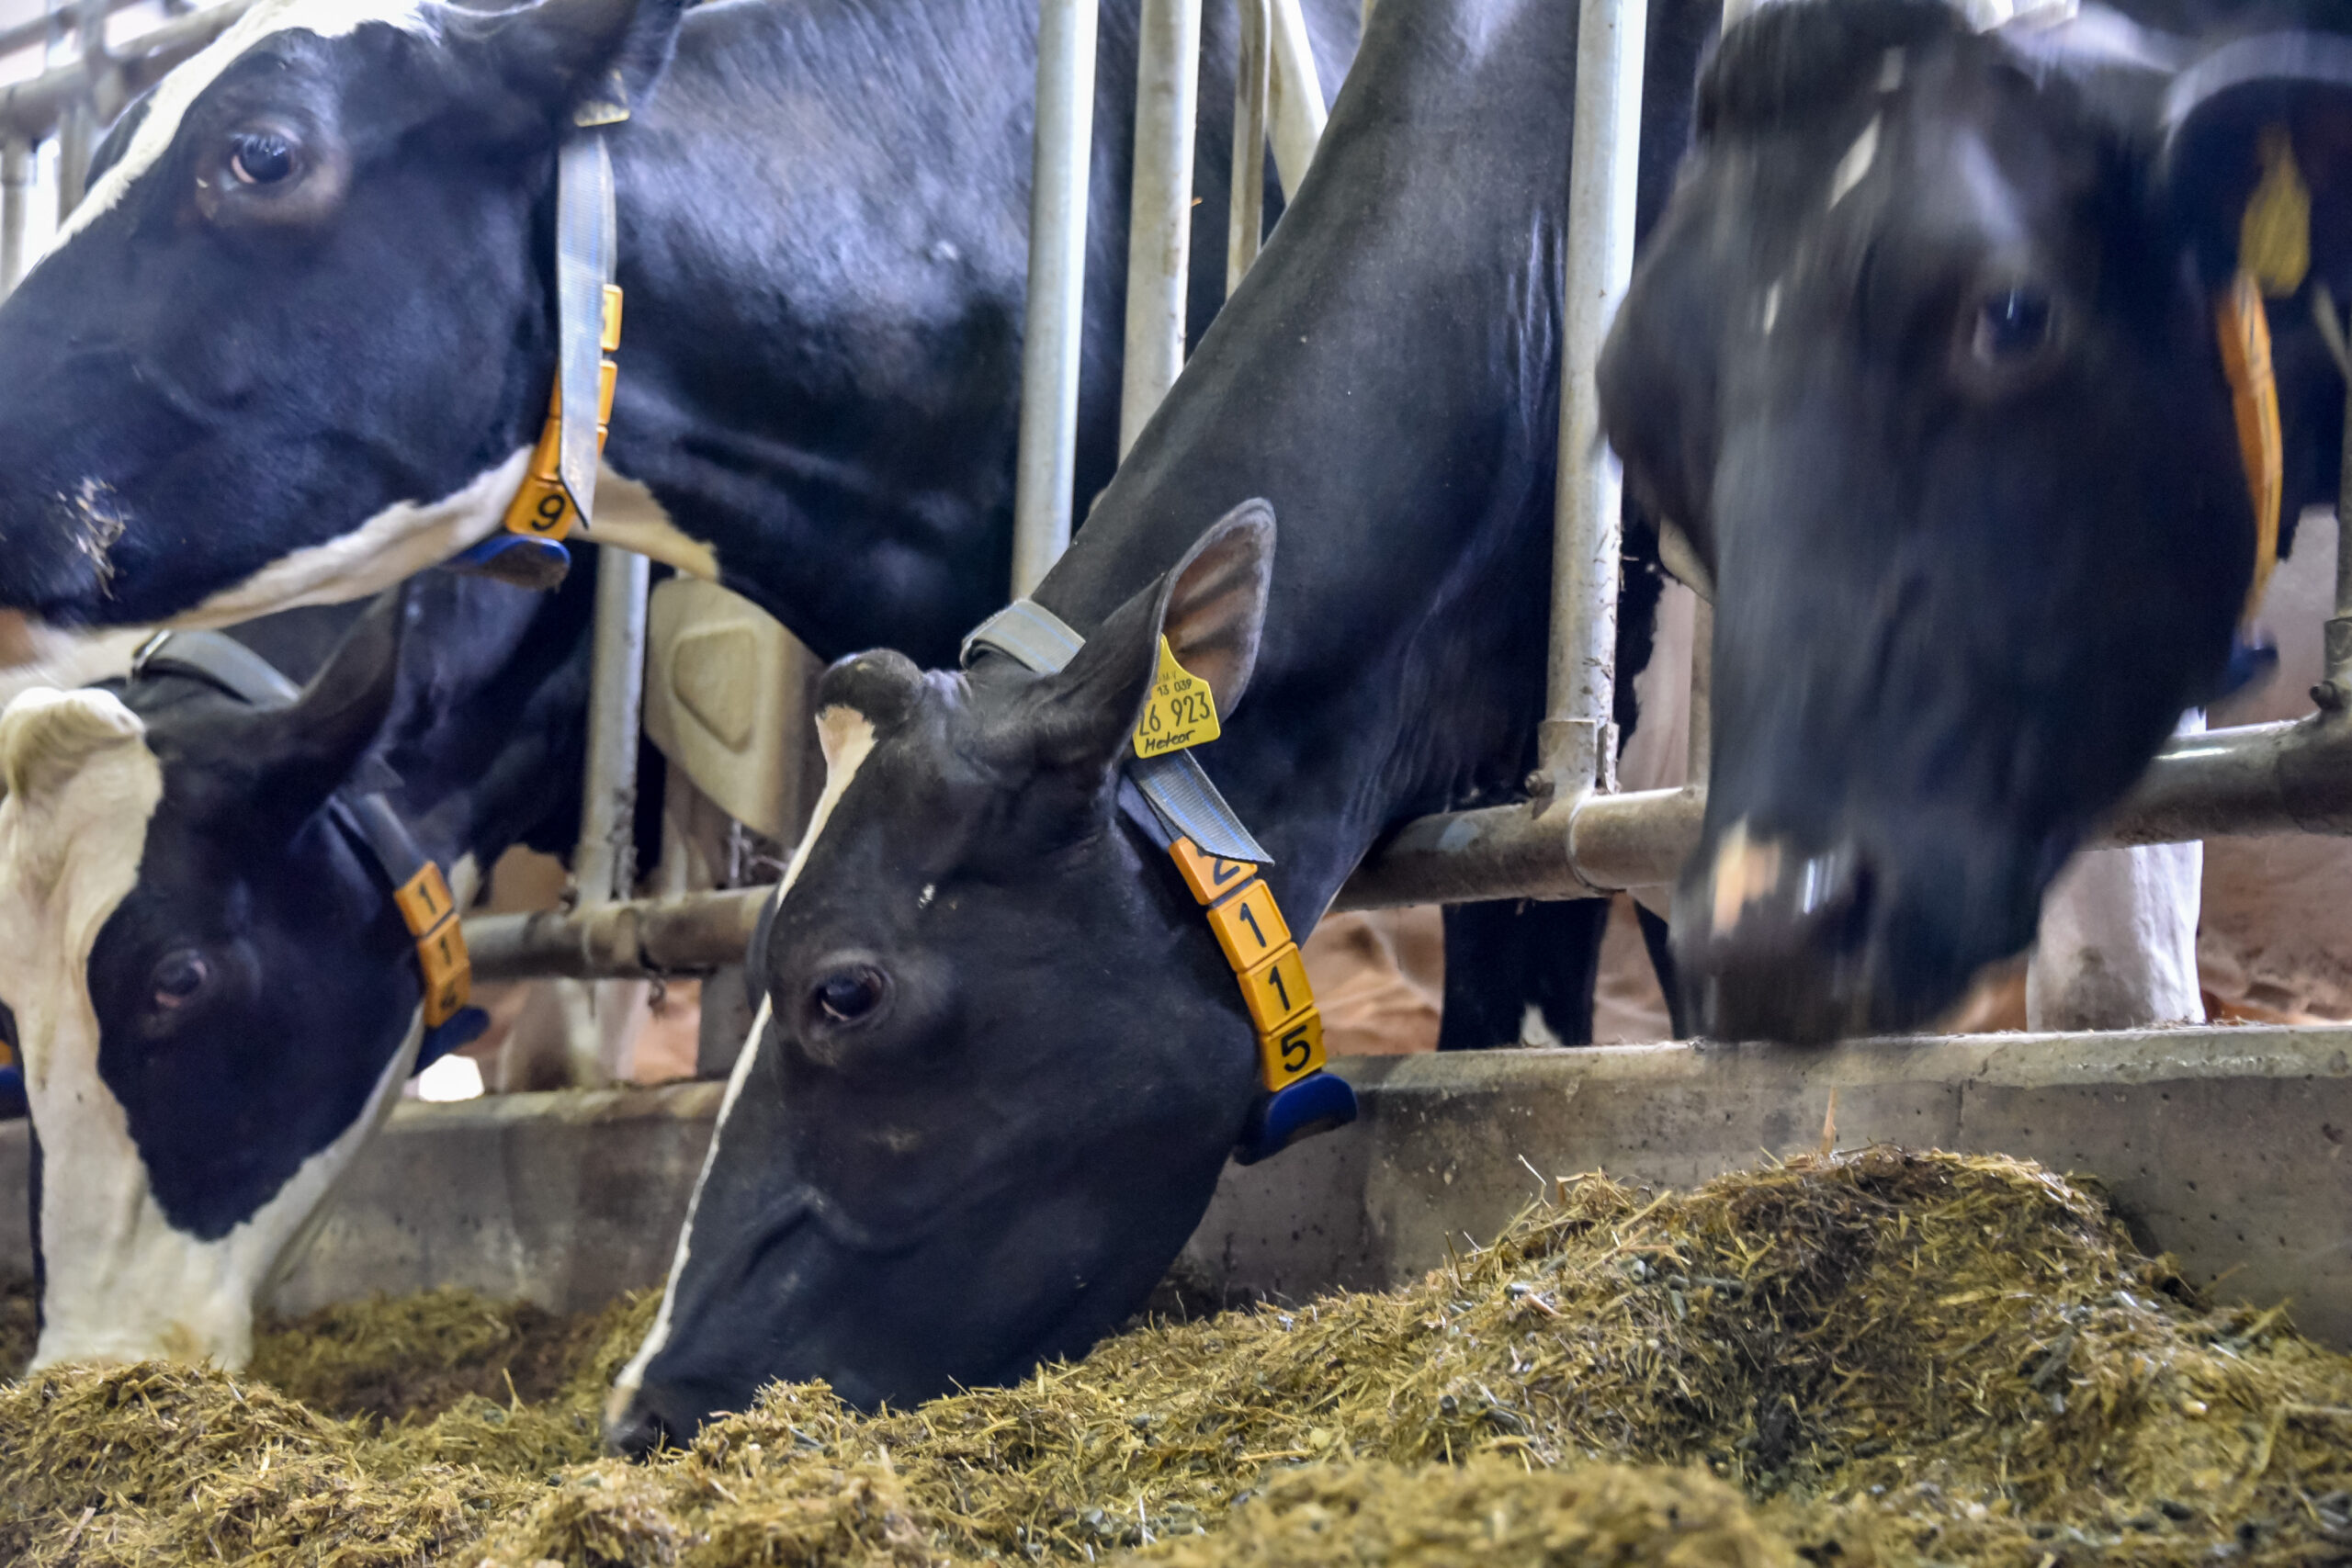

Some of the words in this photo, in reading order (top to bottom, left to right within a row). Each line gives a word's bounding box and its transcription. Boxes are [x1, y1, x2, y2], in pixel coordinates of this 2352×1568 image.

[531, 493, 566, 532] 9
[1157, 683, 1170, 697] 13
[1173, 678, 1193, 692] 039
[1170, 691, 1211, 727] 923
[1144, 729, 1196, 754] Meteor
